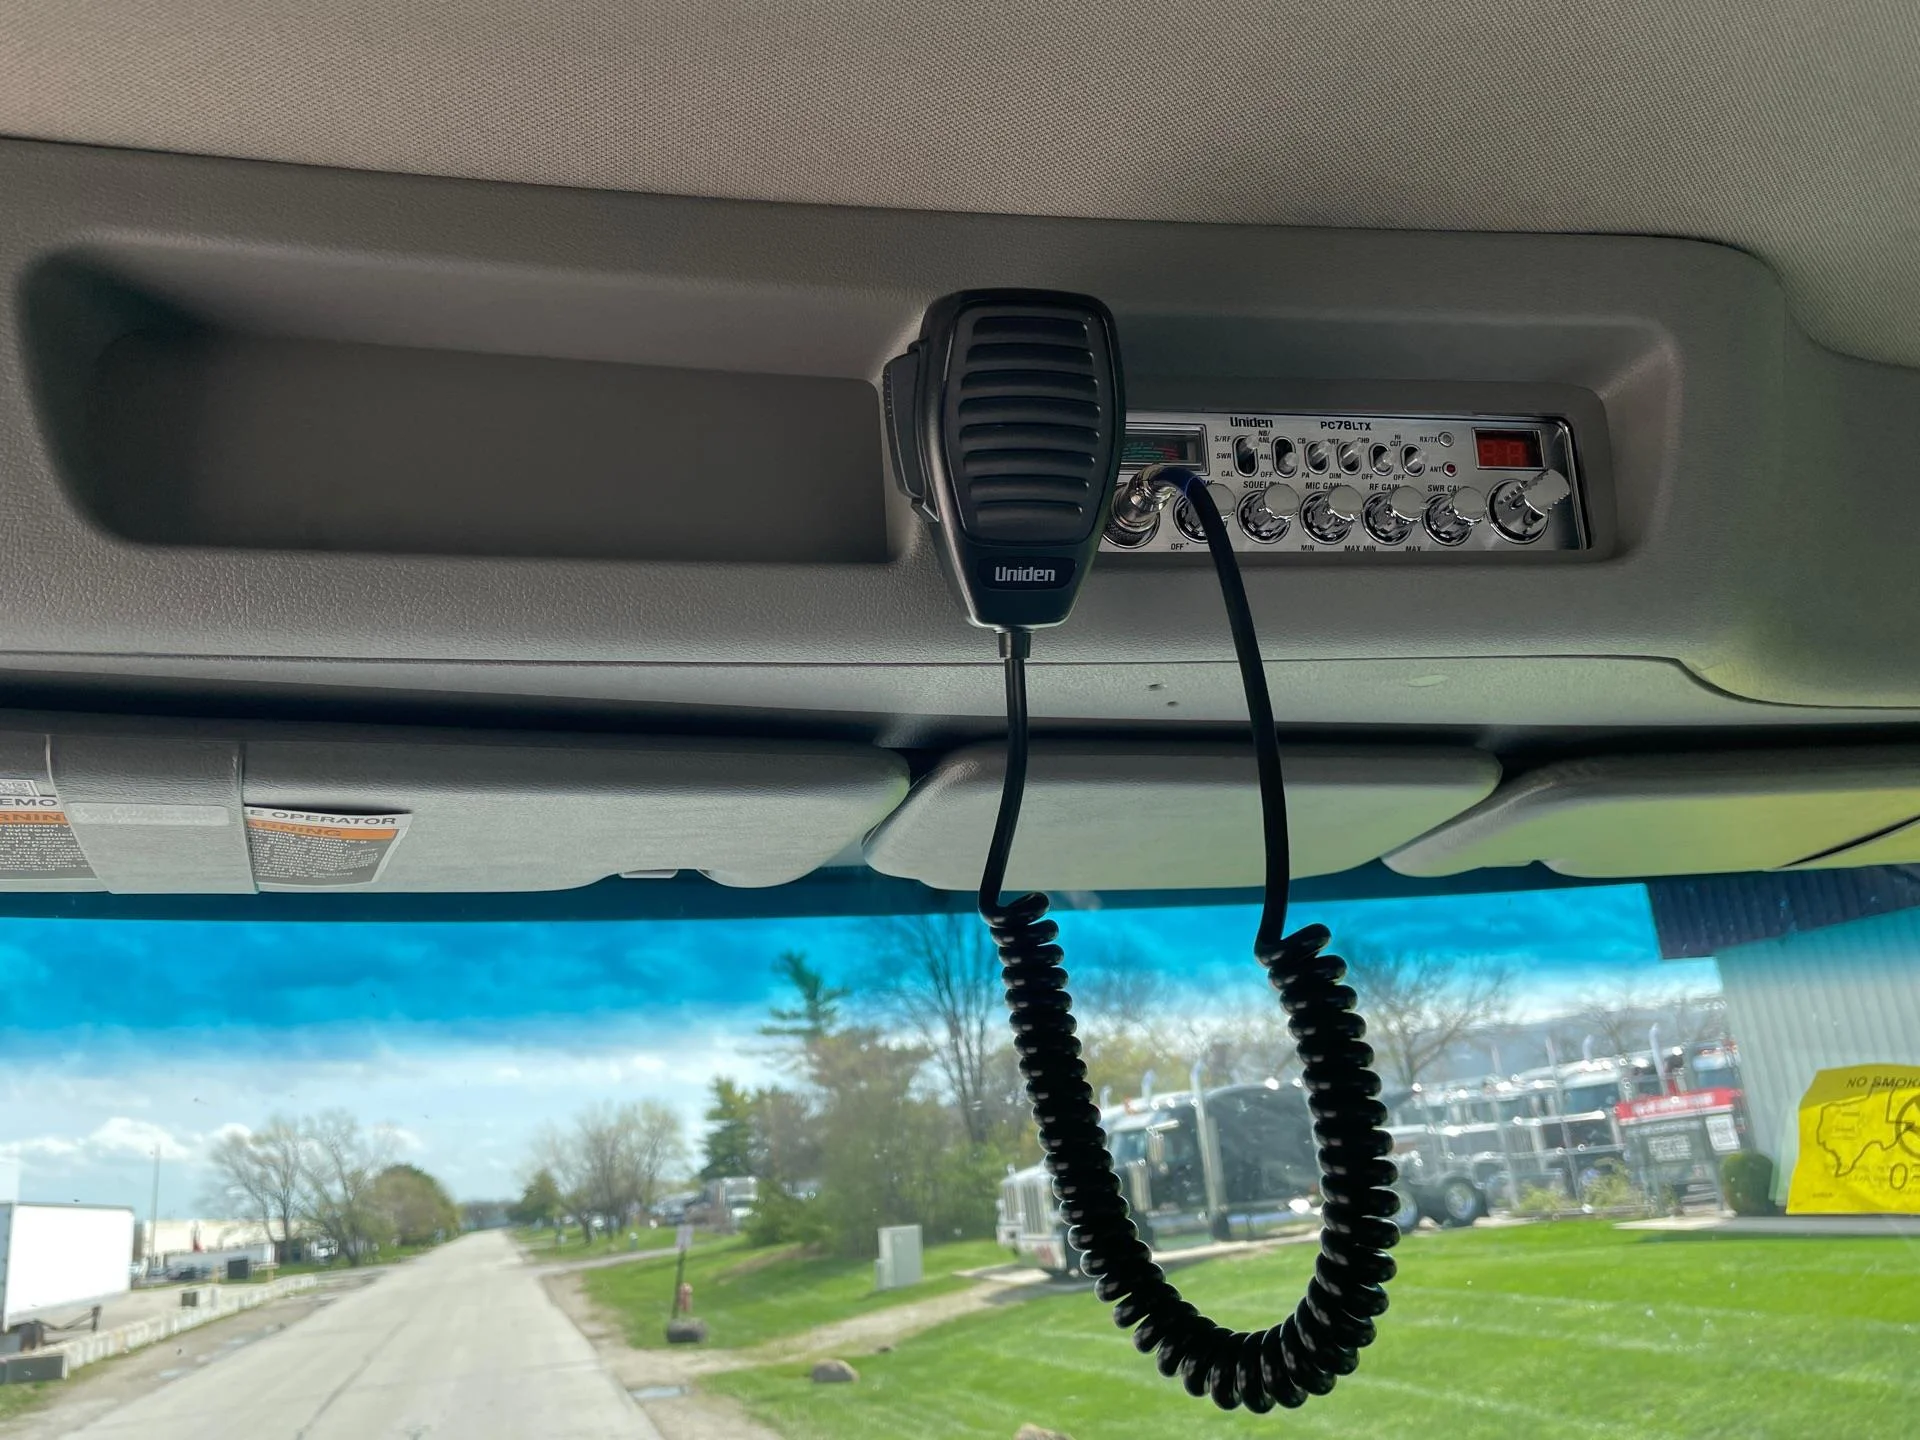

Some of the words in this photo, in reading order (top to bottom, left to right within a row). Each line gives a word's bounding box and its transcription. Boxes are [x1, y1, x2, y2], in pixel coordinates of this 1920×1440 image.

[1229, 416, 1273, 428] Uniden
[1320, 421, 1372, 431] PC78LTX
[1297, 437, 1306, 445] CB
[1216, 452, 1232, 460] SWR
[1259, 453, 1272, 461] ANL
[1221, 470, 1234, 478] CAL
[1260, 471, 1273, 479] OFF
[1301, 471, 1310, 479] PA
[1305, 481, 1321, 490] MIC
[1369, 483, 1380, 491] RF
[1427, 484, 1445, 492] SWR
[1170, 543, 1185, 551] OFF
[1301, 544, 1315, 552] MIN
[994, 565, 1056, 582] Uniden
[271, 811, 397, 826] OPERATOR
[1846, 1076, 1868, 1089] NO
